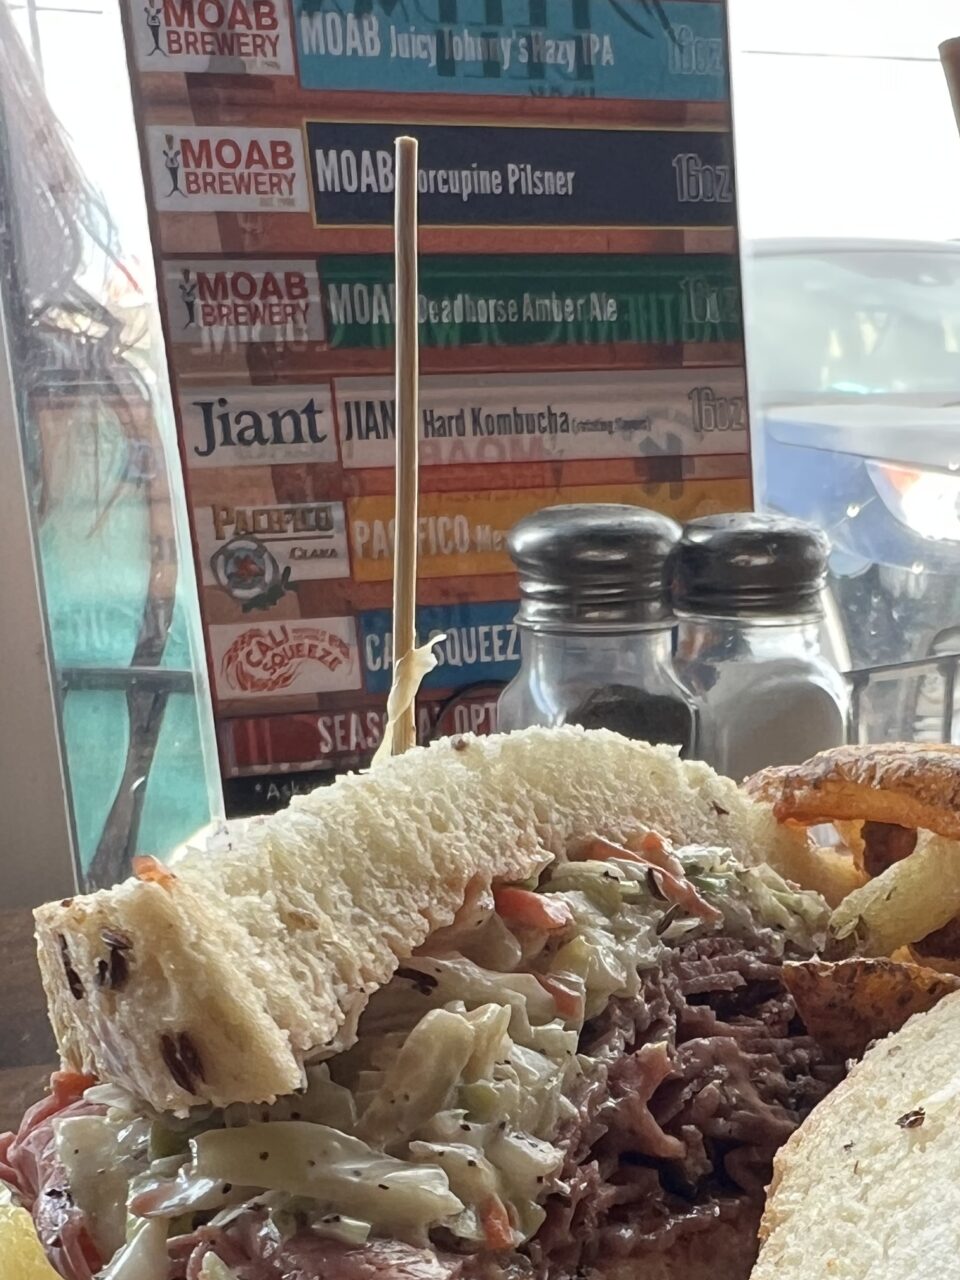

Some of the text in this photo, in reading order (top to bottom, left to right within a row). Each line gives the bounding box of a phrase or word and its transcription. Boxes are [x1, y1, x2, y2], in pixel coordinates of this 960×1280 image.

[164, 0, 279, 31] MOAB
[166, 30, 280, 58] BREWERY
[300, 11, 614, 73] MOAB Juicy Johnny's Hazy IPA
[180, 138, 295, 170] MOAB
[315, 149, 577, 202] MOAB orcupine Pilsner
[184, 171, 297, 197] BREWERY
[672, 152, 732, 203] 16oz
[196, 271, 310, 301] MOAB
[328, 282, 618, 325] MOA Deadhorse Amber Ale
[200, 302, 310, 327] BREWERY
[192, 397, 328, 457] Jiant
[343, 399, 396, 441] JIAN
[422, 408, 466, 438] Hard
[471, 405, 570, 437] Kombucha
[688, 386, 746, 432] 16oz
[353, 514, 470, 560] PAFICO
[246, 624, 290, 668] CALI
[262, 642, 343, 675] SQUEEZE
[428, 624, 520, 667] SQUEEZ
[317, 701, 497, 754] SEASA OPT
